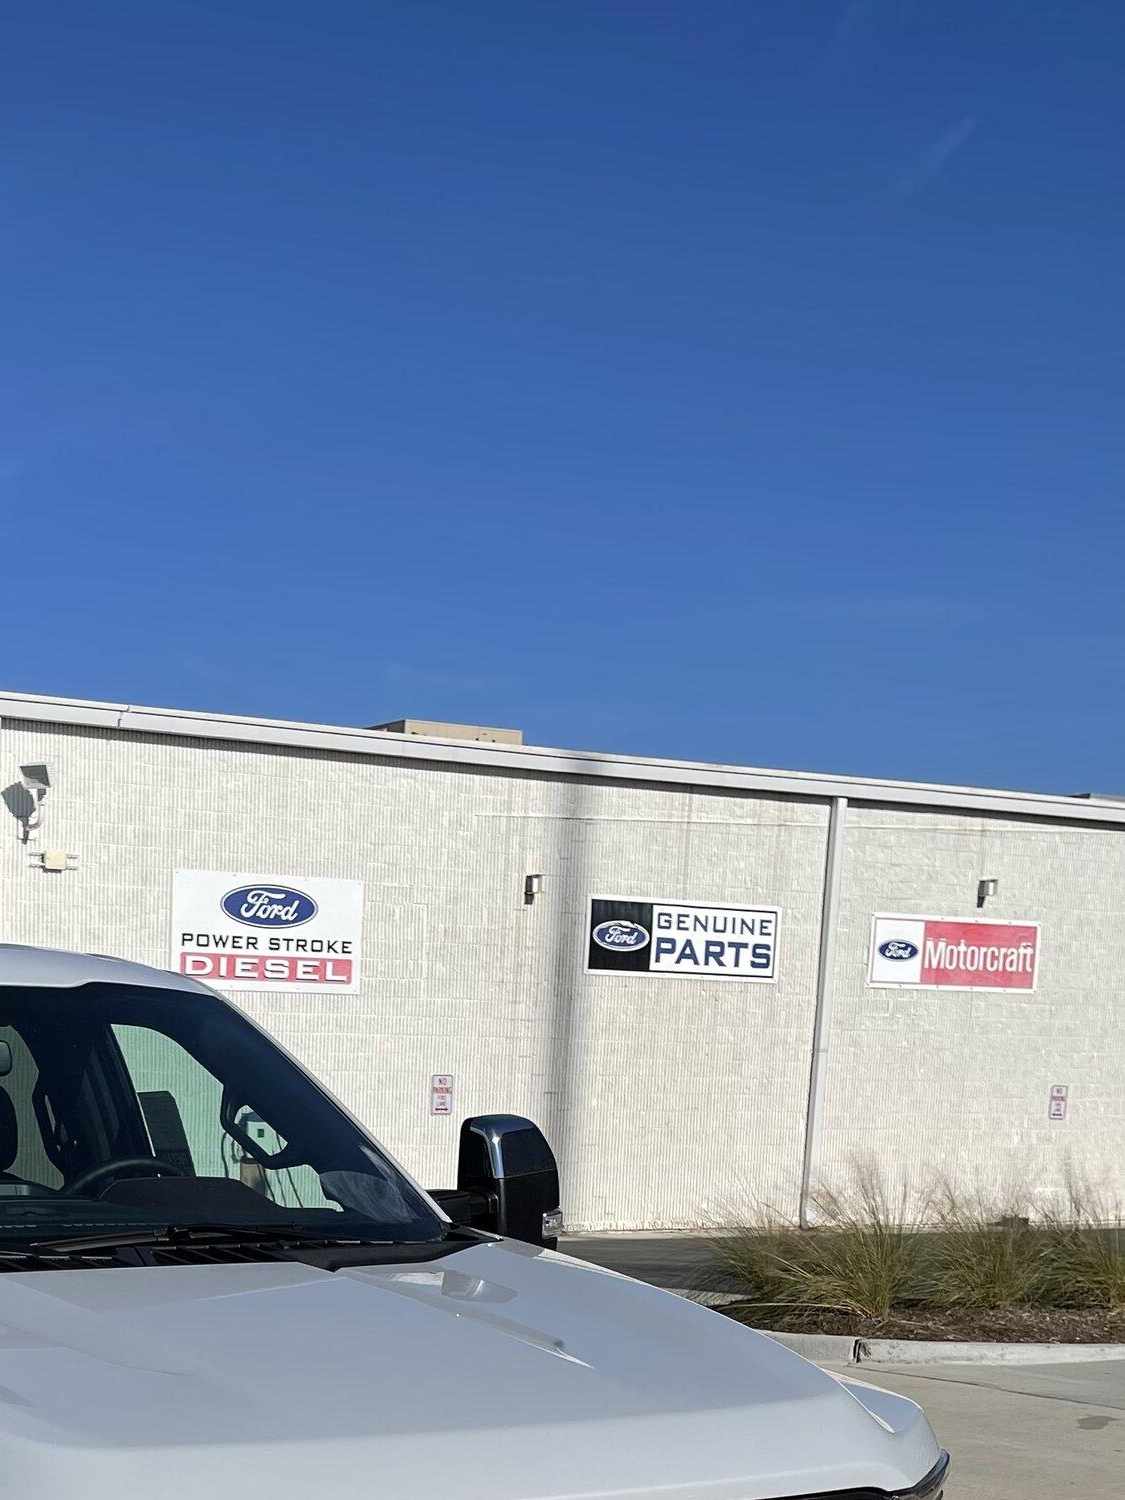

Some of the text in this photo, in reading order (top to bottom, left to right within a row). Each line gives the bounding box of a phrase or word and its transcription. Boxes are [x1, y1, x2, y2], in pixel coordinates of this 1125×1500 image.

[240, 890, 300, 921] Ford
[605, 926, 637, 944] Ford
[657, 912, 773, 936] GENUINE
[181, 932, 353, 954] POWER STROKE
[655, 937, 772, 969] PARTS
[885, 942, 912, 958] Ford
[924, 939, 1035, 973] Motorcraft
[184, 954, 348, 983] DIESEL
